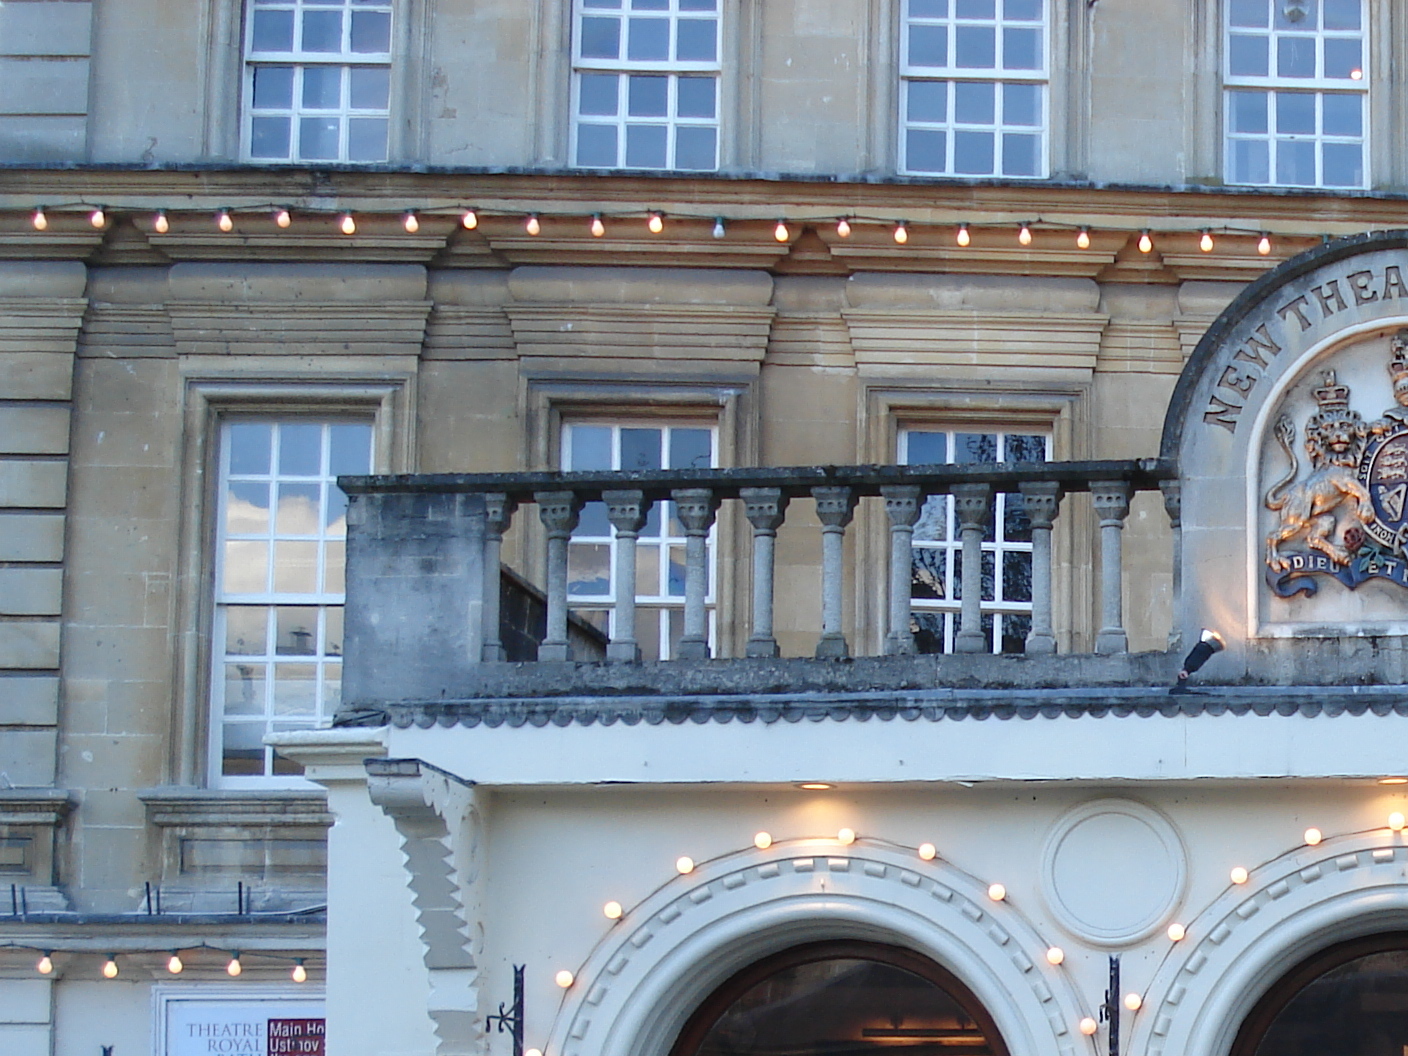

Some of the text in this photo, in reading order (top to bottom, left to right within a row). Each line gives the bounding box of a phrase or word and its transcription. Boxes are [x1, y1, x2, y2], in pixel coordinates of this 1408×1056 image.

[1203, 323, 1284, 434] NEW
[1358, 450, 1373, 480] SOIT
[1292, 554, 1341, 575] DIEU
[1367, 560, 1397, 576] ET
[186, 1022, 263, 1037] THEATRE
[269, 1021, 302, 1037] Main
[207, 1038, 263, 1053] ROYAL
